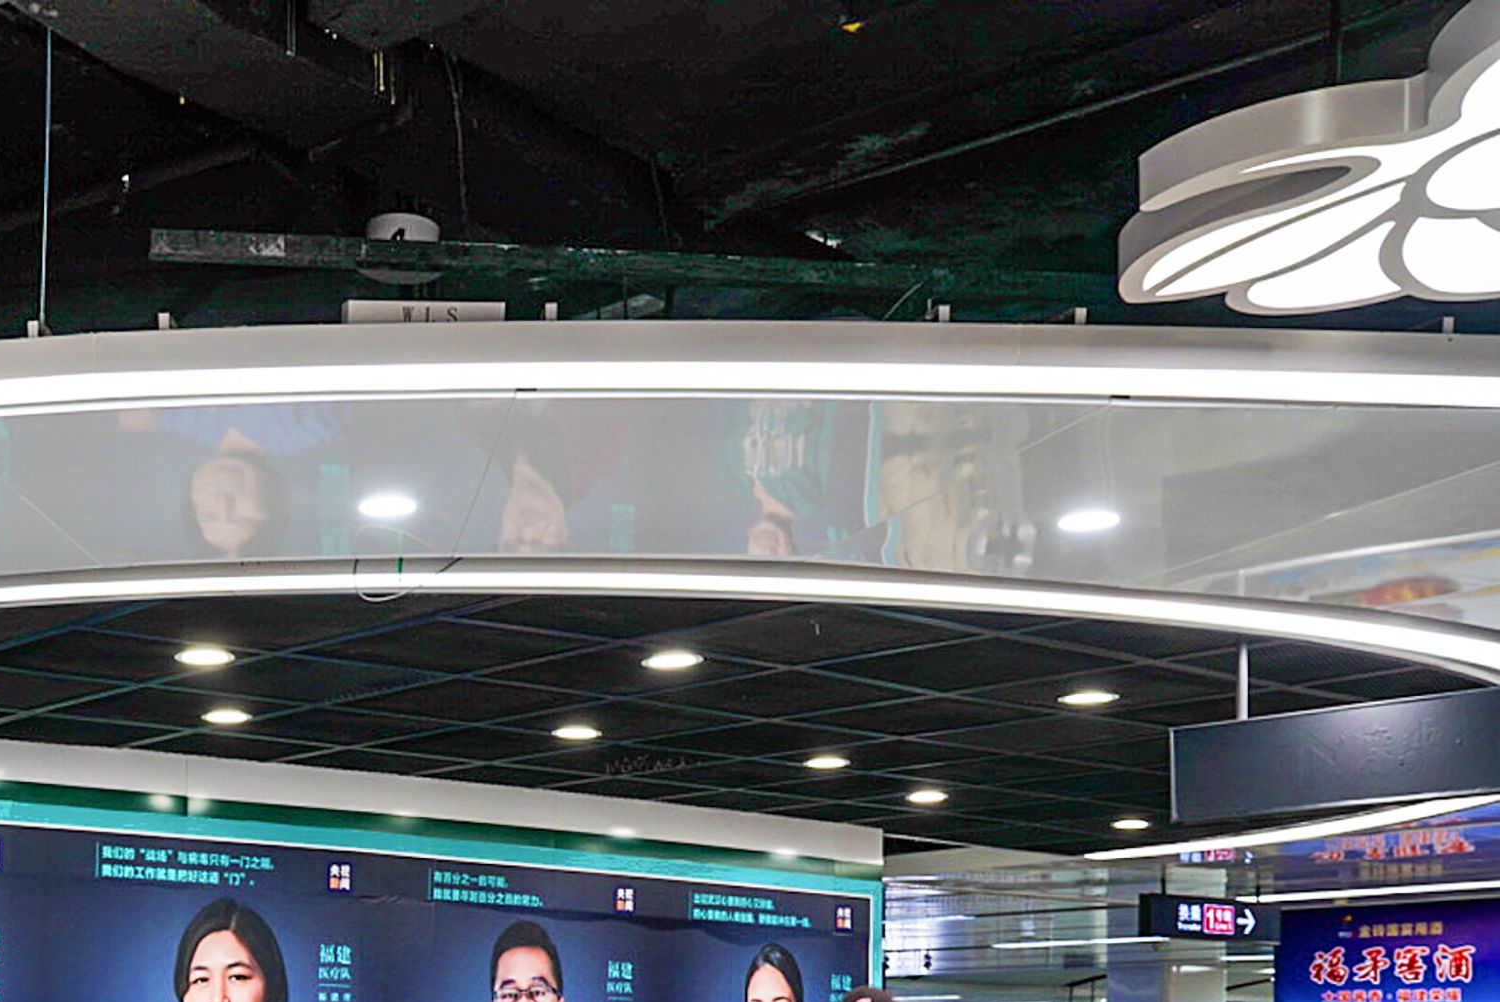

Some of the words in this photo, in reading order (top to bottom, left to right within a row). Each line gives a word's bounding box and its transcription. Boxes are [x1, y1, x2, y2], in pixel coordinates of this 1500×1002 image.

[319, 943, 352, 965] 福建
[1310, 945, 1476, 986] 福矛窖酒
